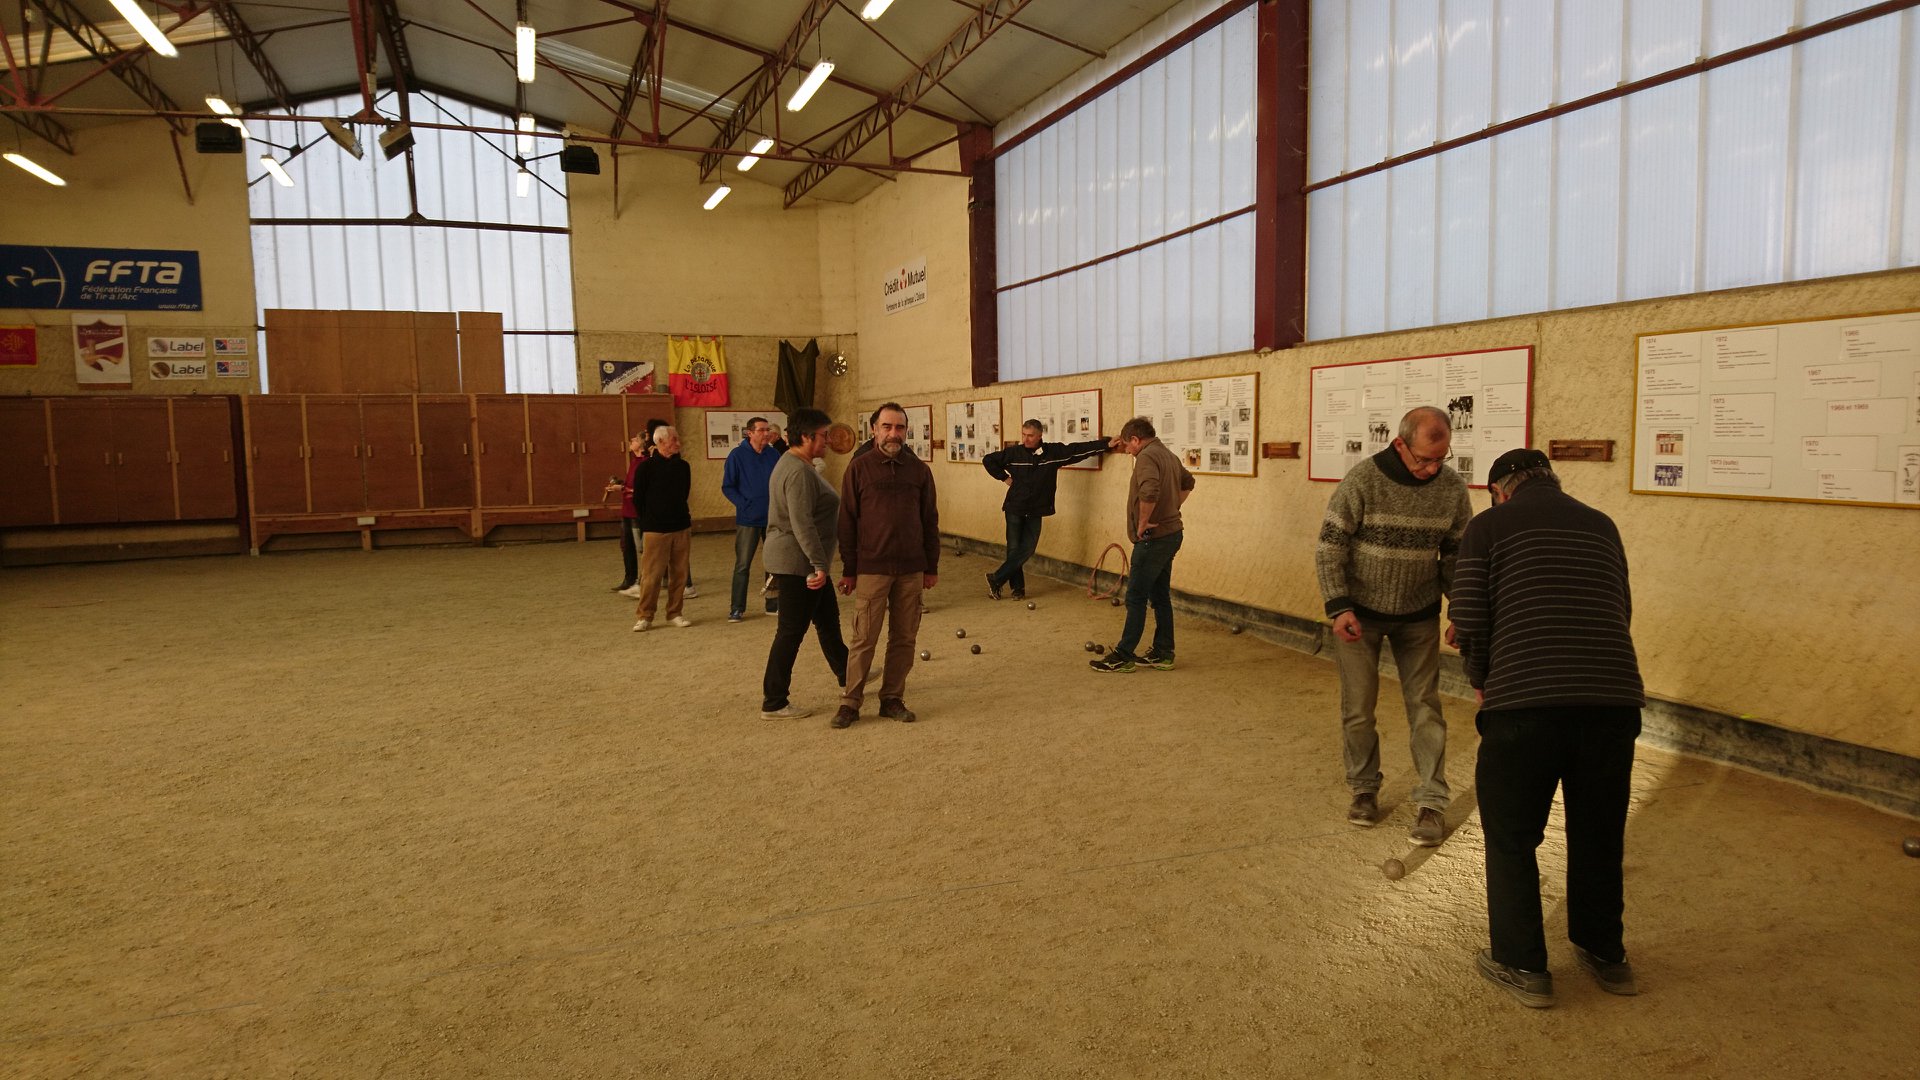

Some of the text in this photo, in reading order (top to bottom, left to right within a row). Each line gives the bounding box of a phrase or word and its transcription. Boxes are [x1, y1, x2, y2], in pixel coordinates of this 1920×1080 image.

[884, 265, 926, 297] Crédit Mutuel
[82, 285, 178, 295] Fédération Française
[169, 341, 204, 352] Label
[171, 363, 206, 375] Label
